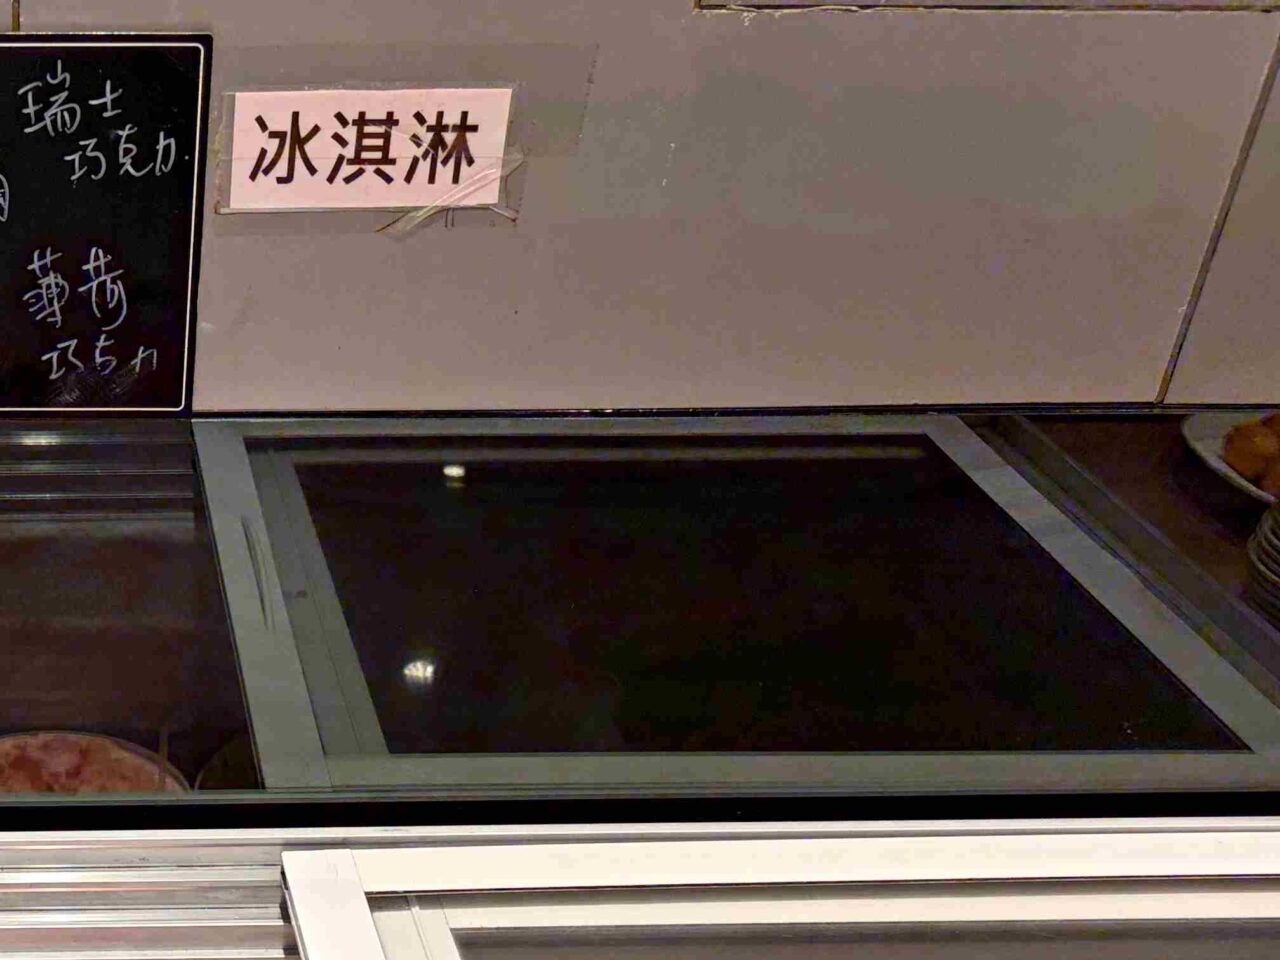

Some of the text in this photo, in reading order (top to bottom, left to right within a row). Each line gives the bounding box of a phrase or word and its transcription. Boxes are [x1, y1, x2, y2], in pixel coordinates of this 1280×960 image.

[18, 60, 123, 136] 瑞士
[63, 124, 177, 181] 巧克力
[248, 110, 479, 185] 冰淇淋
[22, 247, 127, 331] 薄荷
